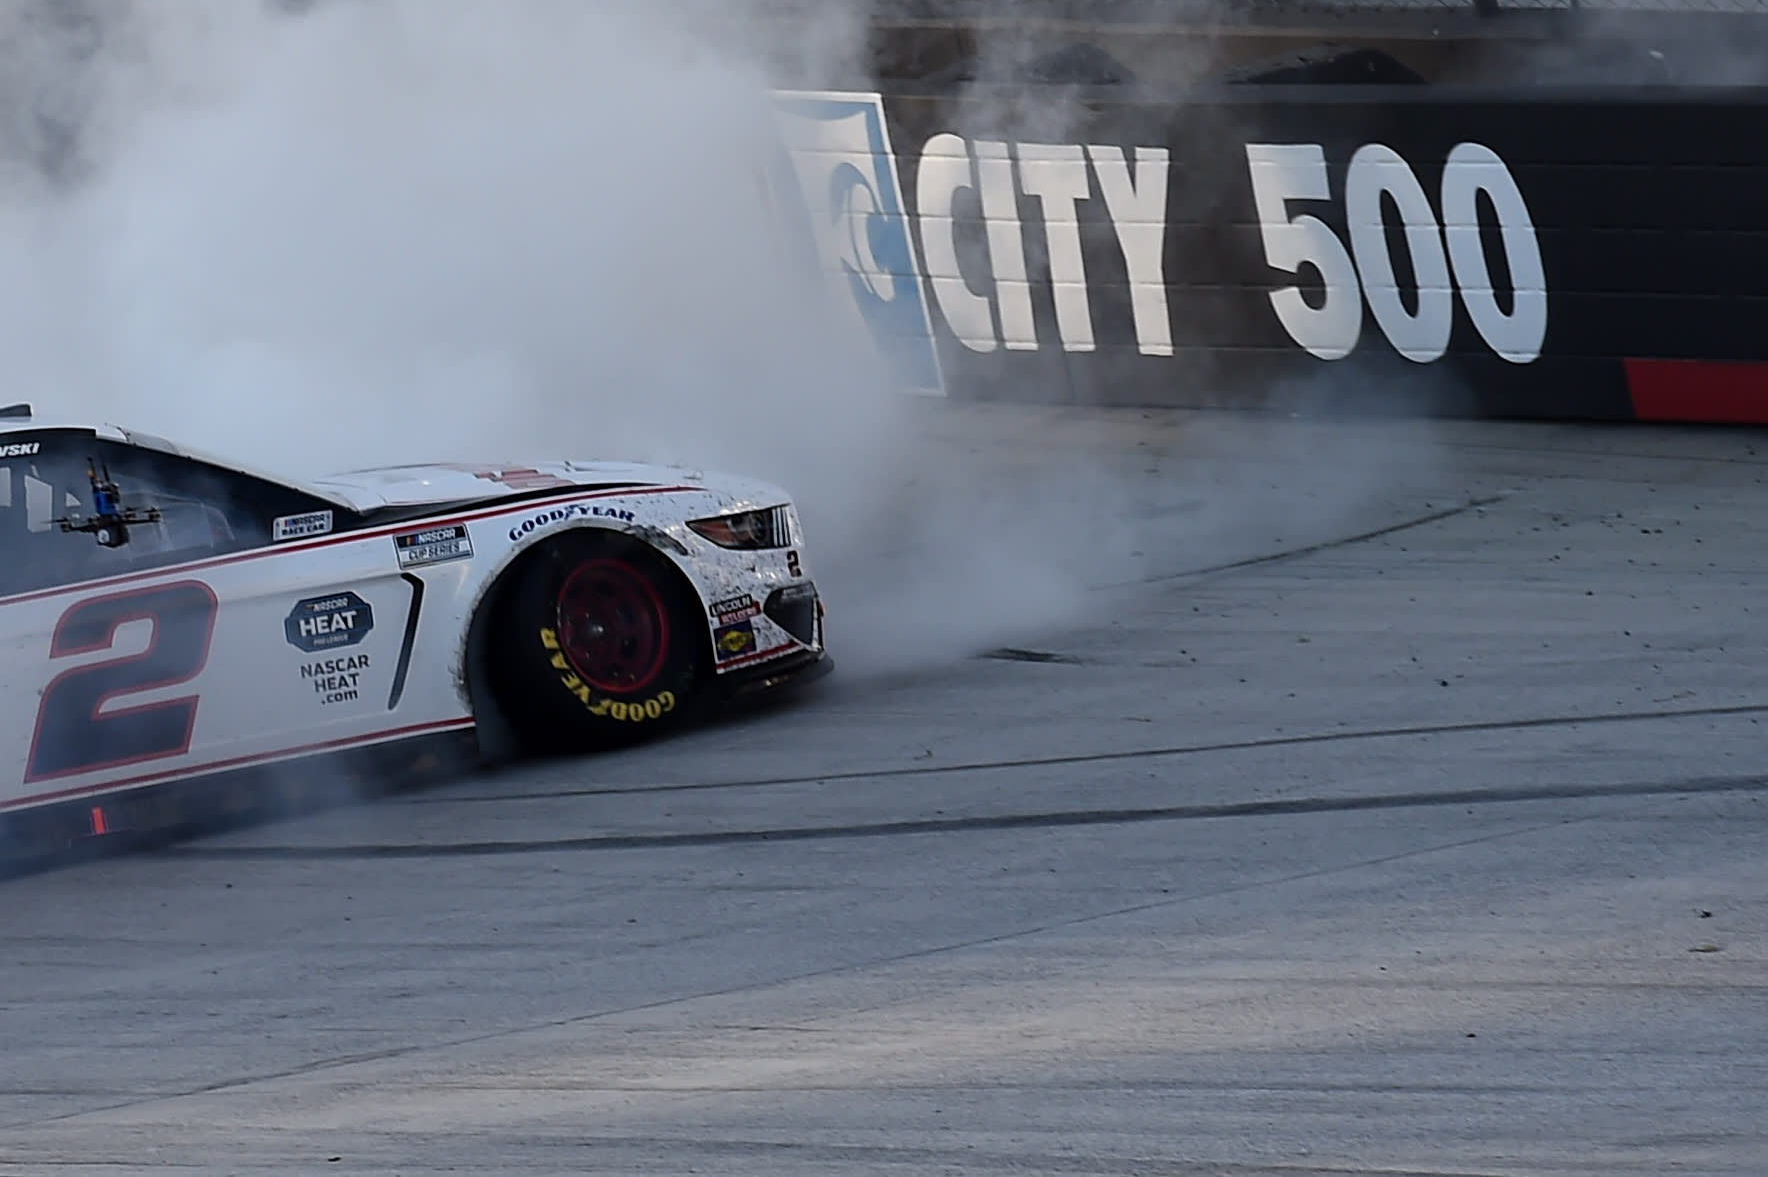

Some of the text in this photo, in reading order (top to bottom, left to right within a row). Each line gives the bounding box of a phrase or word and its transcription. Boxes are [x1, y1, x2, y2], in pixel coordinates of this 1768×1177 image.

[916, 133, 1548, 364] CITY 500
[282, 523, 325, 536] RACE CAR
[509, 504, 635, 541] GOODYEAR
[417, 528, 456, 544] NASCAR
[408, 542, 460, 561] CUP SERIES
[786, 550, 802, 578] 2
[314, 597, 348, 612] NASCAR
[711, 597, 751, 616] LINCOLN
[299, 611, 357, 637] HEAT
[300, 654, 370, 679] NASCAR
[540, 627, 675, 722] GOODYEAR
[24, 579, 218, 784] 2
[314, 673, 360, 693] HEAT
[321, 689, 358, 705] .com
